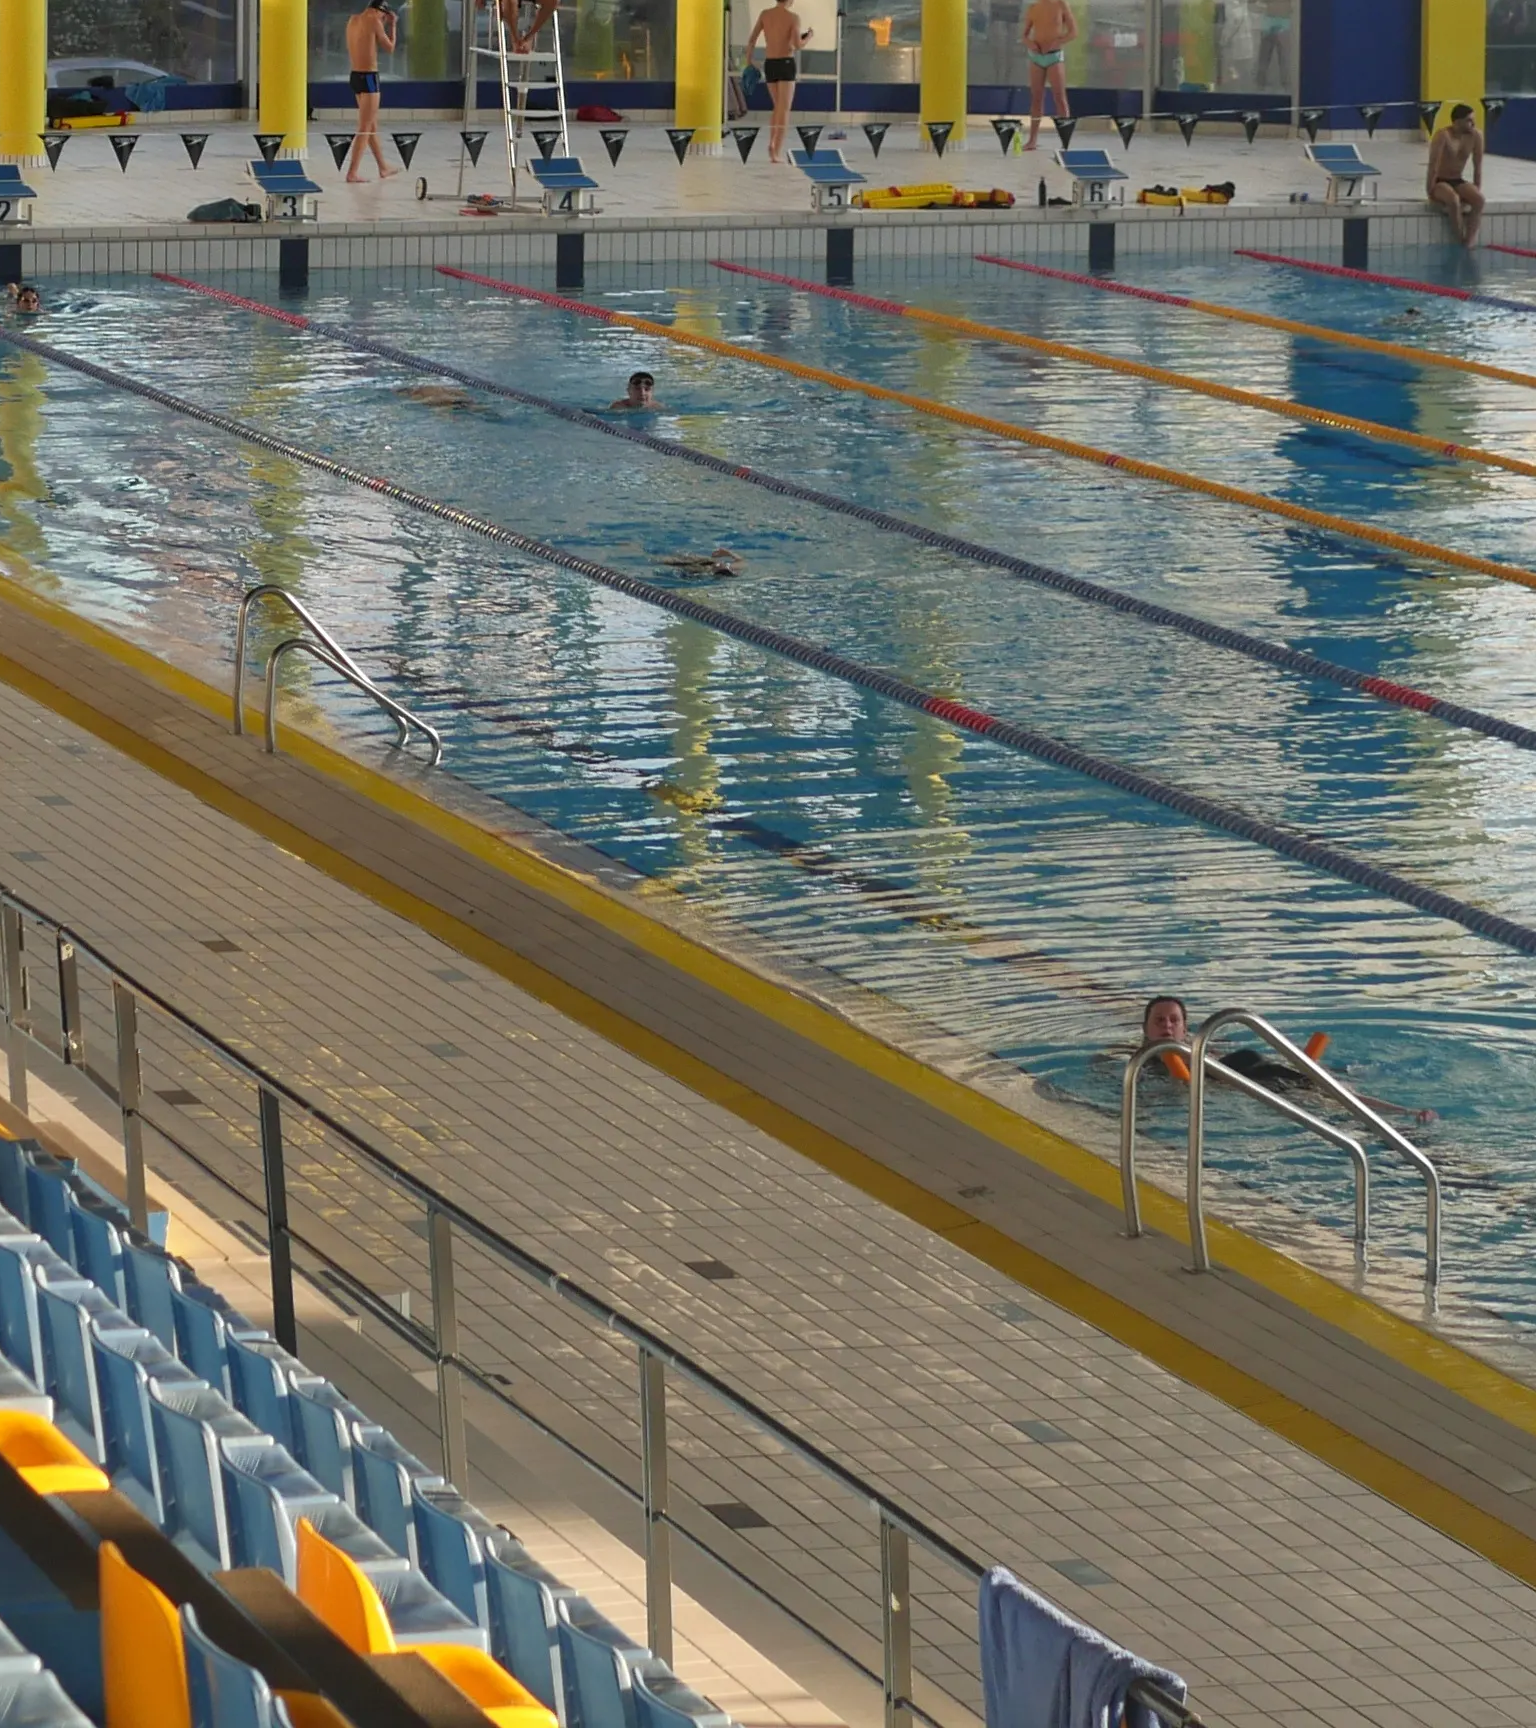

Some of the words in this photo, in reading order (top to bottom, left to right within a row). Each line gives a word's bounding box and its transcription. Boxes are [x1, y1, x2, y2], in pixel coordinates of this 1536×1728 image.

[558, 190, 573, 212] 4
[828, 185, 842, 207] 5
[1089, 182, 1104, 203] 6
[282, 196, 297, 217] 3
